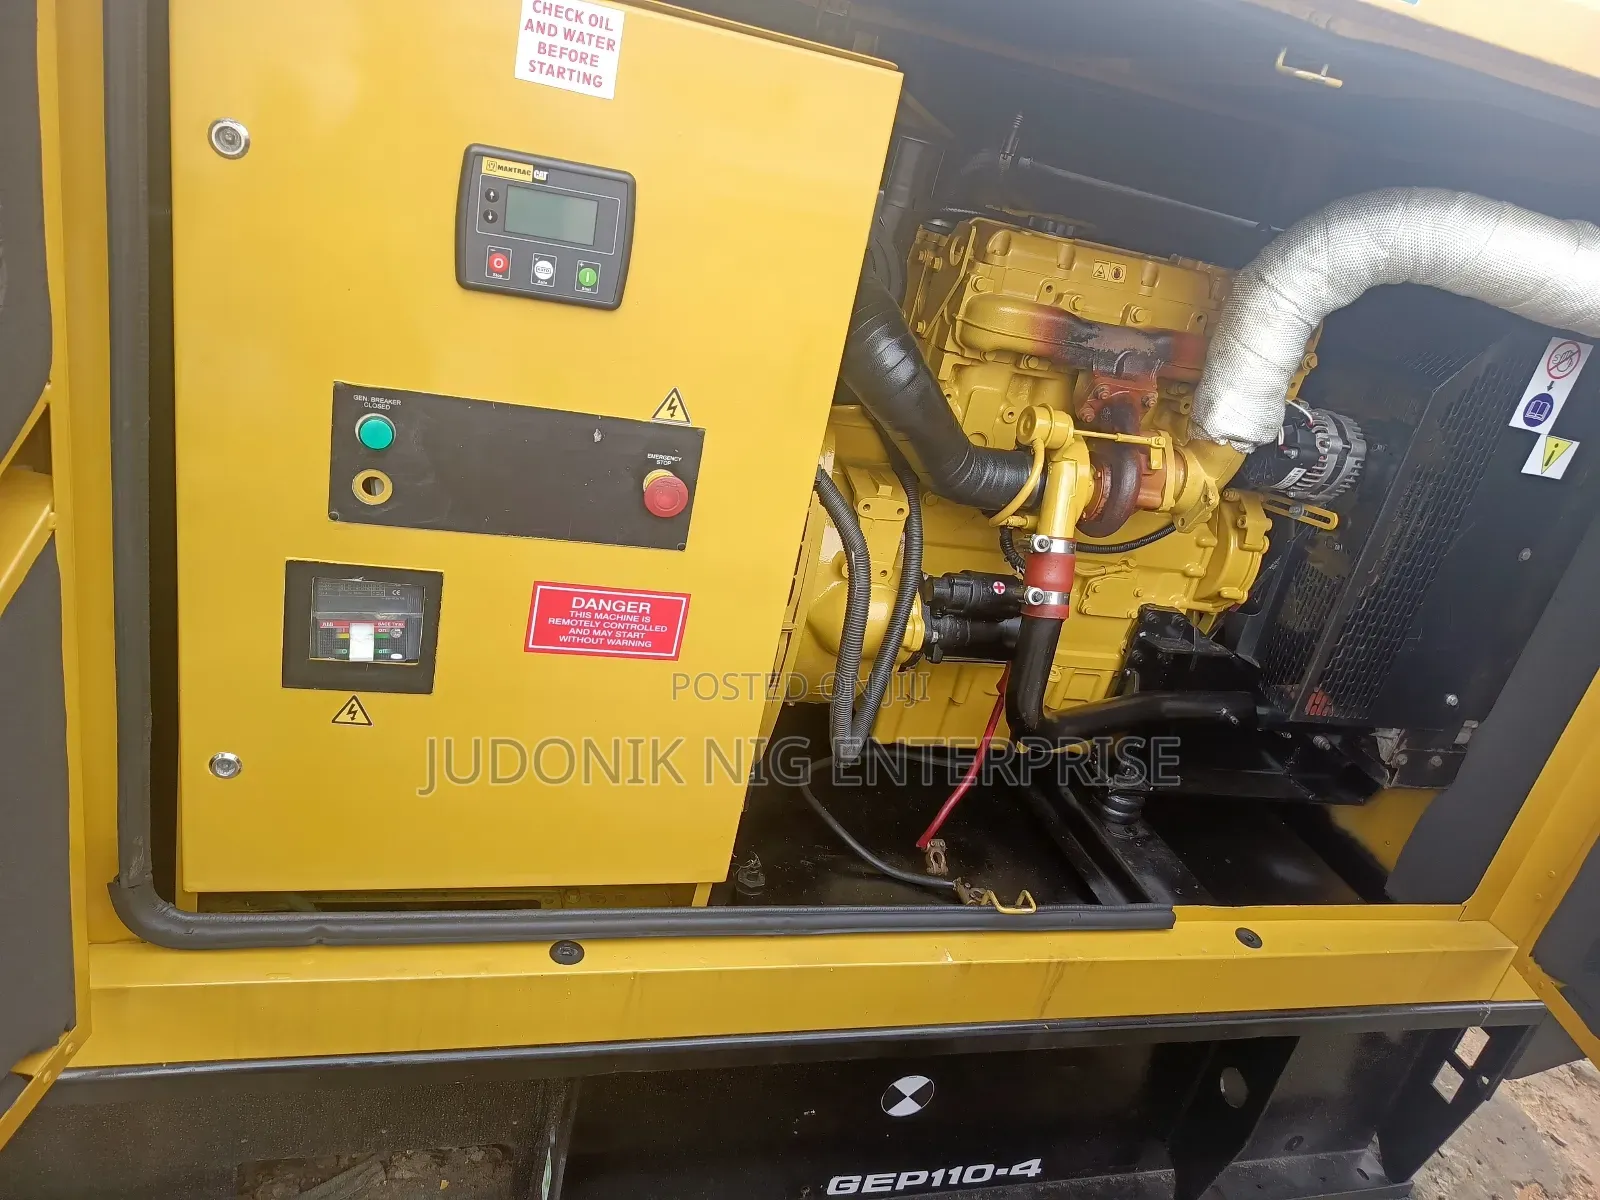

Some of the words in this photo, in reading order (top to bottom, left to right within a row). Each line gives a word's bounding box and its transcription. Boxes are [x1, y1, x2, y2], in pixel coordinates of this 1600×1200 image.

[532, 0, 585, 24] CHECK
[588, 14, 613, 31] OIL
[524, 18, 558, 37] AND
[563, 27, 616, 52] WATER
[537, 41, 600, 68] BEFORE
[528, 59, 603, 88] STARTING
[497, 164, 531, 176] MANTRAC
[534, 169, 549, 181] CAT
[353, 394, 369, 402] GEN.
[370, 396, 402, 406] BREAKER
[363, 402, 391, 410] CLOSED
[647, 453, 682, 462] EMERGENCY
[571, 596, 651, 614] DANGER
[569, 610, 592, 619] THIS
[594, 612, 639, 623] MACHINE
[548, 617, 601, 628] REMOTELY
[603, 622, 668, 633] CONTROLLED
[568, 627, 590, 636] AND
[592, 629, 614, 638] MAY
[615, 631, 646, 639] START
[559, 635, 604, 645] WITHOUT
[606, 638, 652, 648] WARNING
[827, 1158, 1042, 1196] GEP110-4
